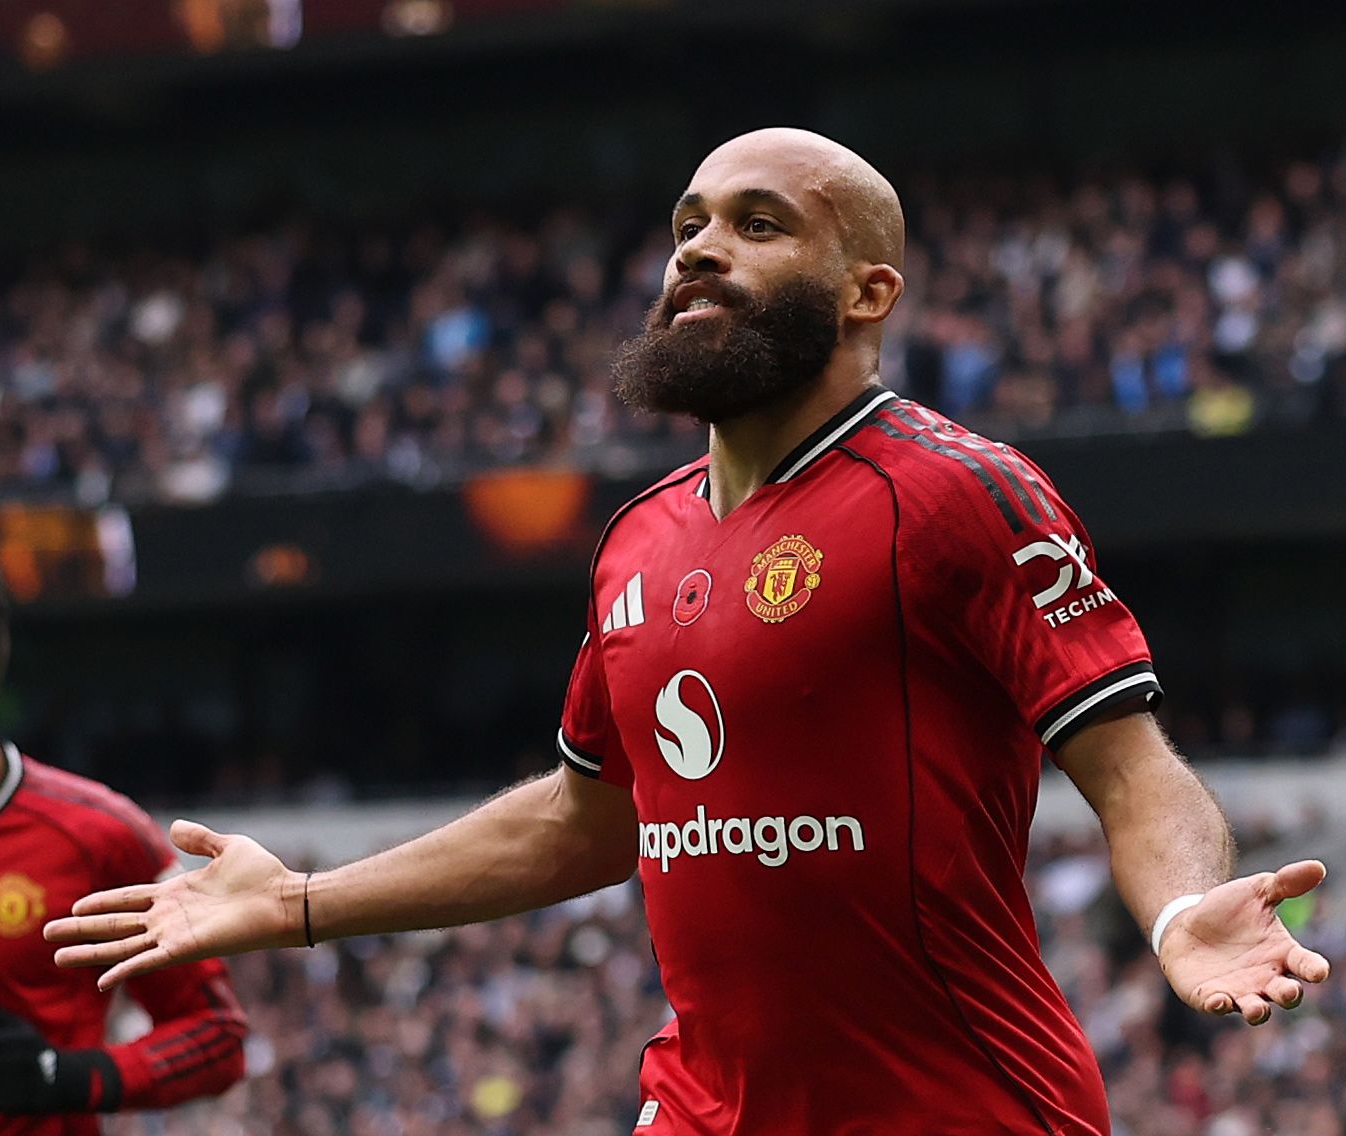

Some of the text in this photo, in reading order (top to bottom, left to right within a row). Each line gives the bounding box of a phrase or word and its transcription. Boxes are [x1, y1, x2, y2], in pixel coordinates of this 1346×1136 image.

[756, 541, 817, 570] MANCHESTER
[755, 600, 798, 617] UNITED
[1043, 587, 1118, 628] TECHN
[639, 805, 864, 873] napdragon
